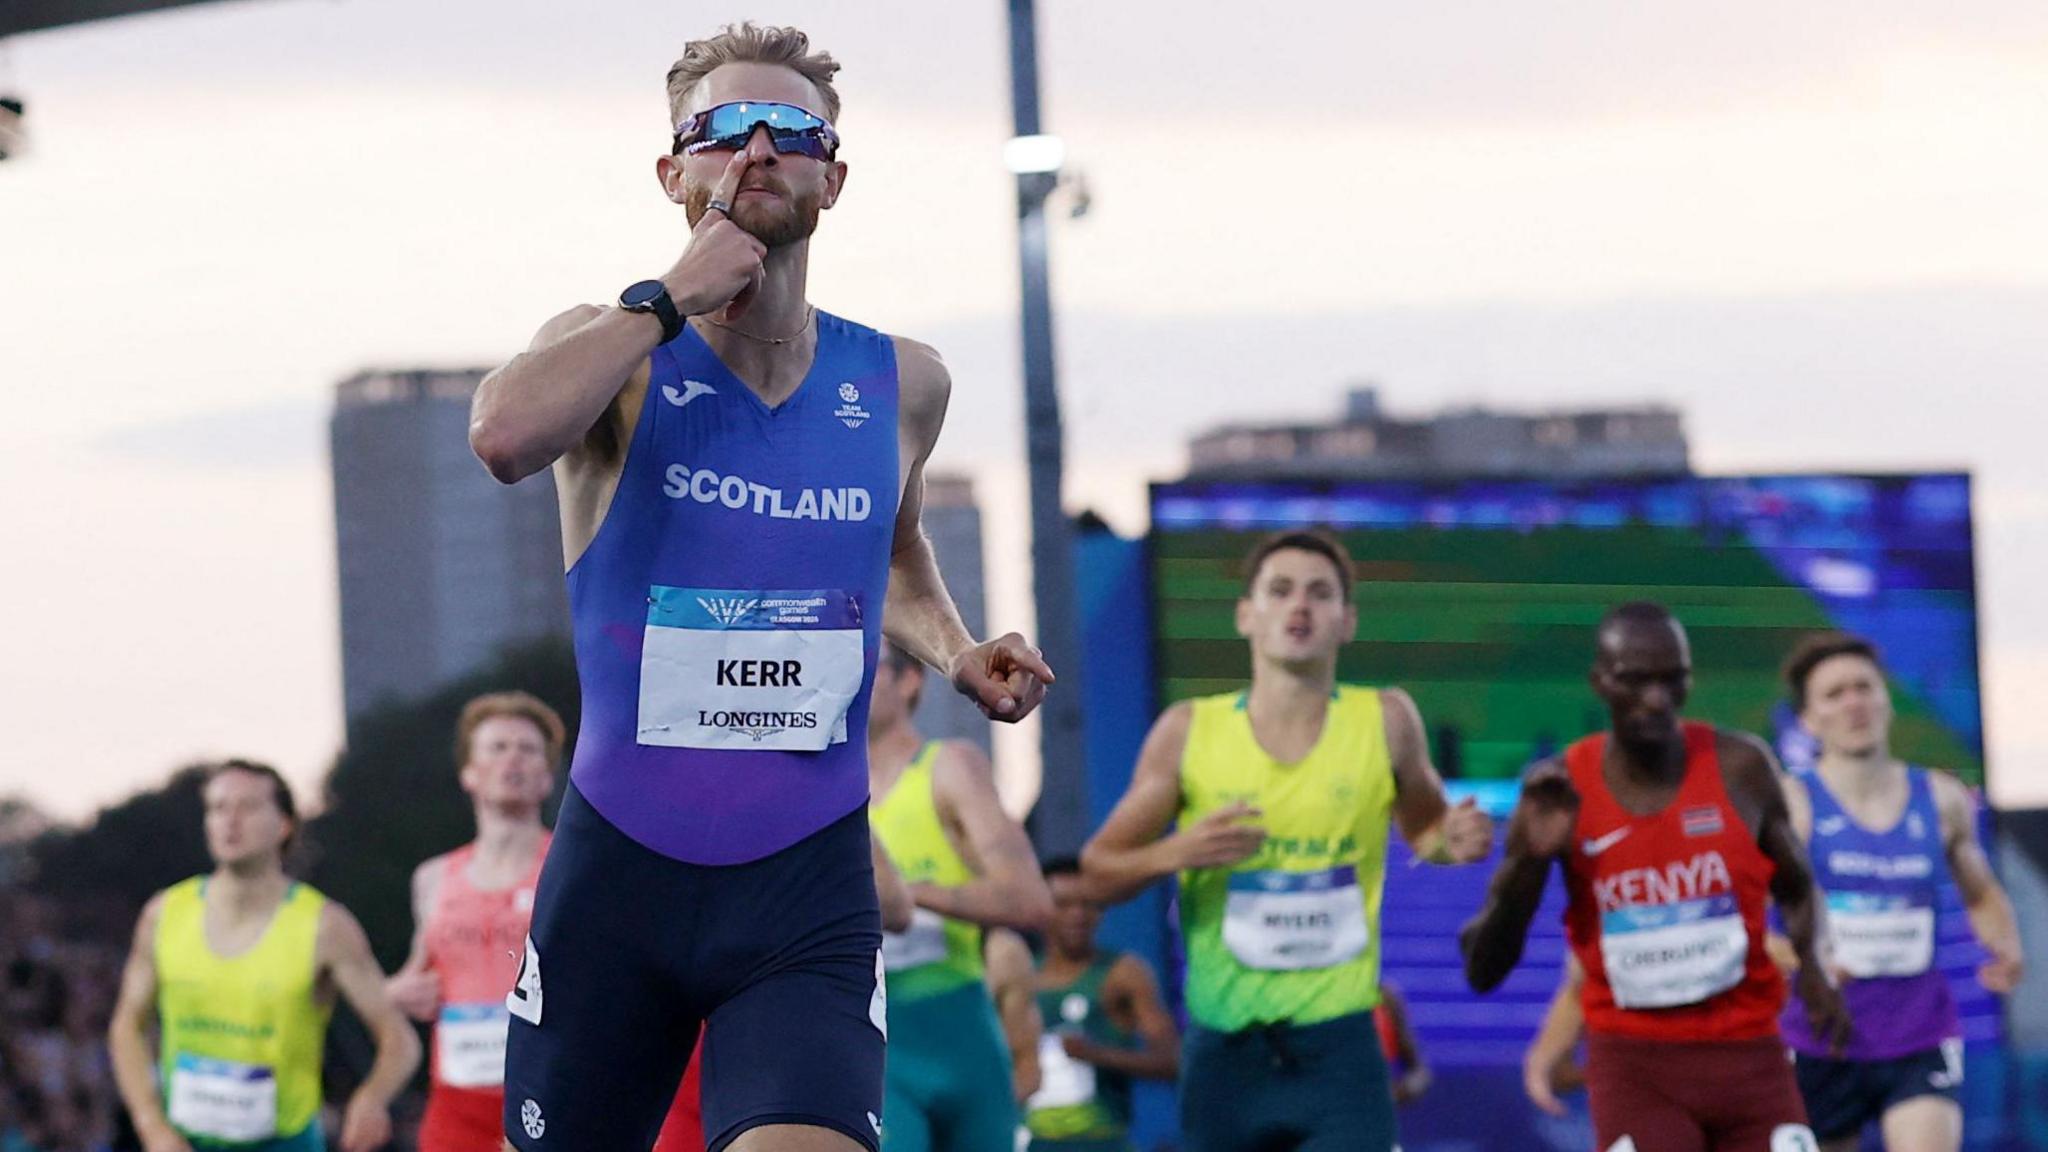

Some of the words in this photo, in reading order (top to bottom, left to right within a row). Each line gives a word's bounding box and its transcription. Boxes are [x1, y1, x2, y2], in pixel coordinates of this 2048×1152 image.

[834, 410, 871, 419] SCOTLAND
[663, 463, 872, 522] SCOTLAND
[760, 597, 827, 608] commonwealth
[779, 606, 809, 616] games
[716, 659, 802, 687] KERR
[698, 710, 817, 728] LONGINES
[1593, 850, 1732, 909] KENYA
